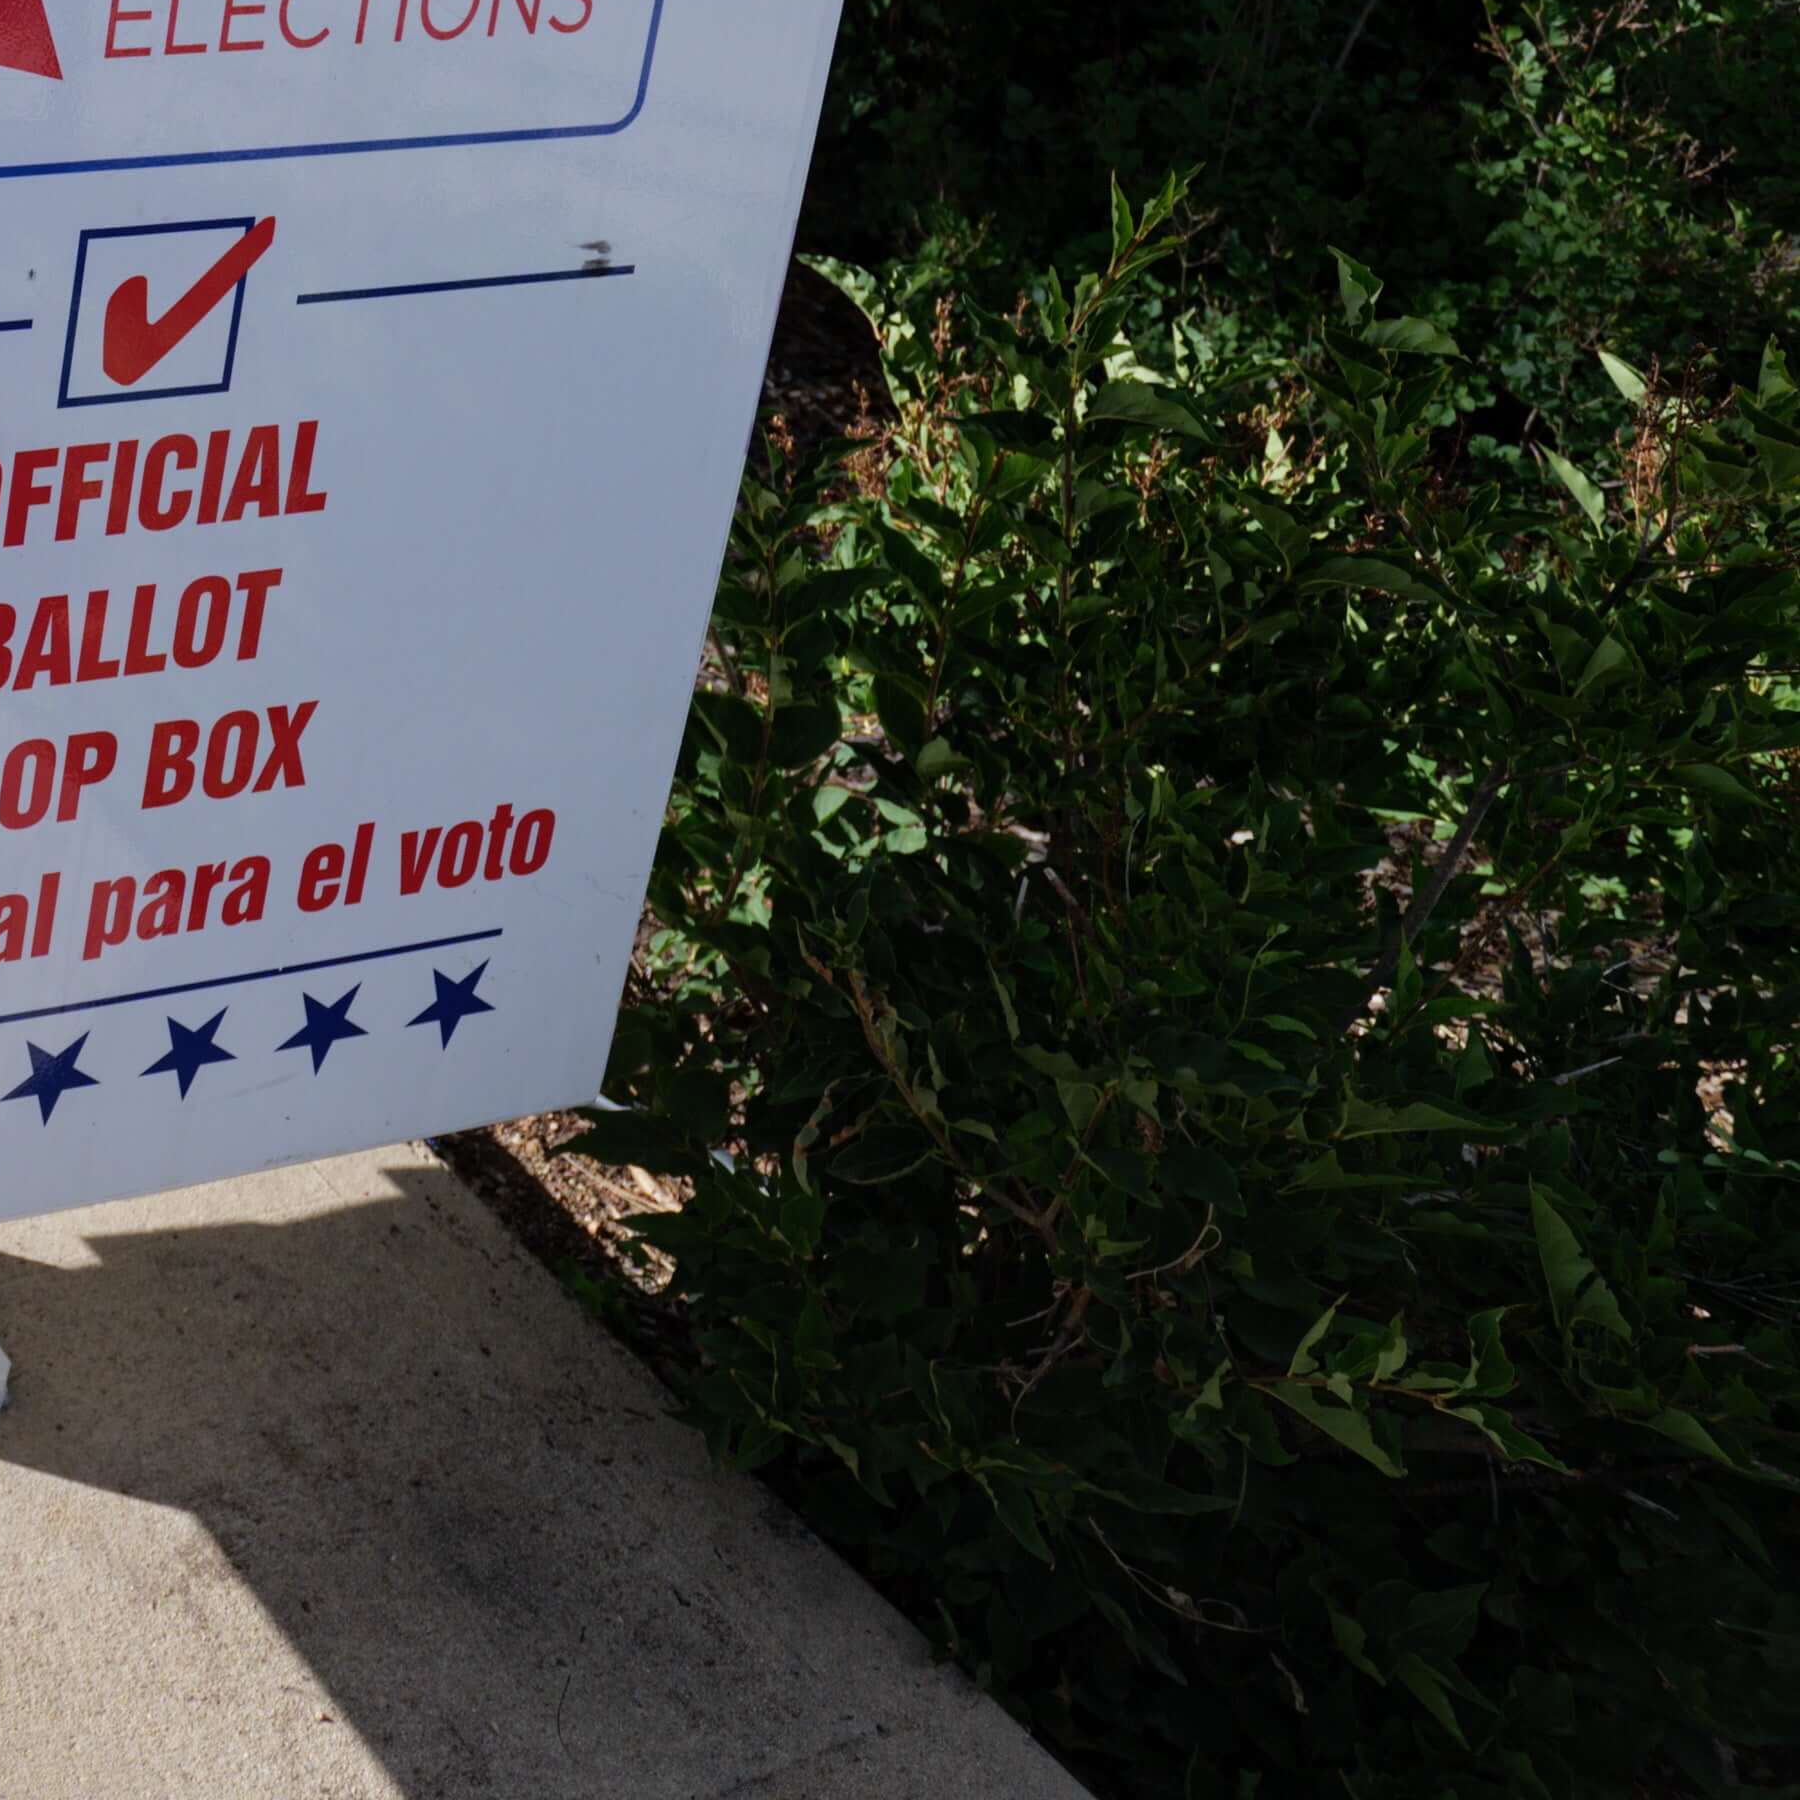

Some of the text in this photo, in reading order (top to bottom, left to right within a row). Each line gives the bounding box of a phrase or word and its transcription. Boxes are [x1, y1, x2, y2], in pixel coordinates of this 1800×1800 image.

[141, 701, 319, 809] BOX
[83, 855, 272, 961] para
[297, 822, 375, 913] el
[399, 803, 556, 895] voto
